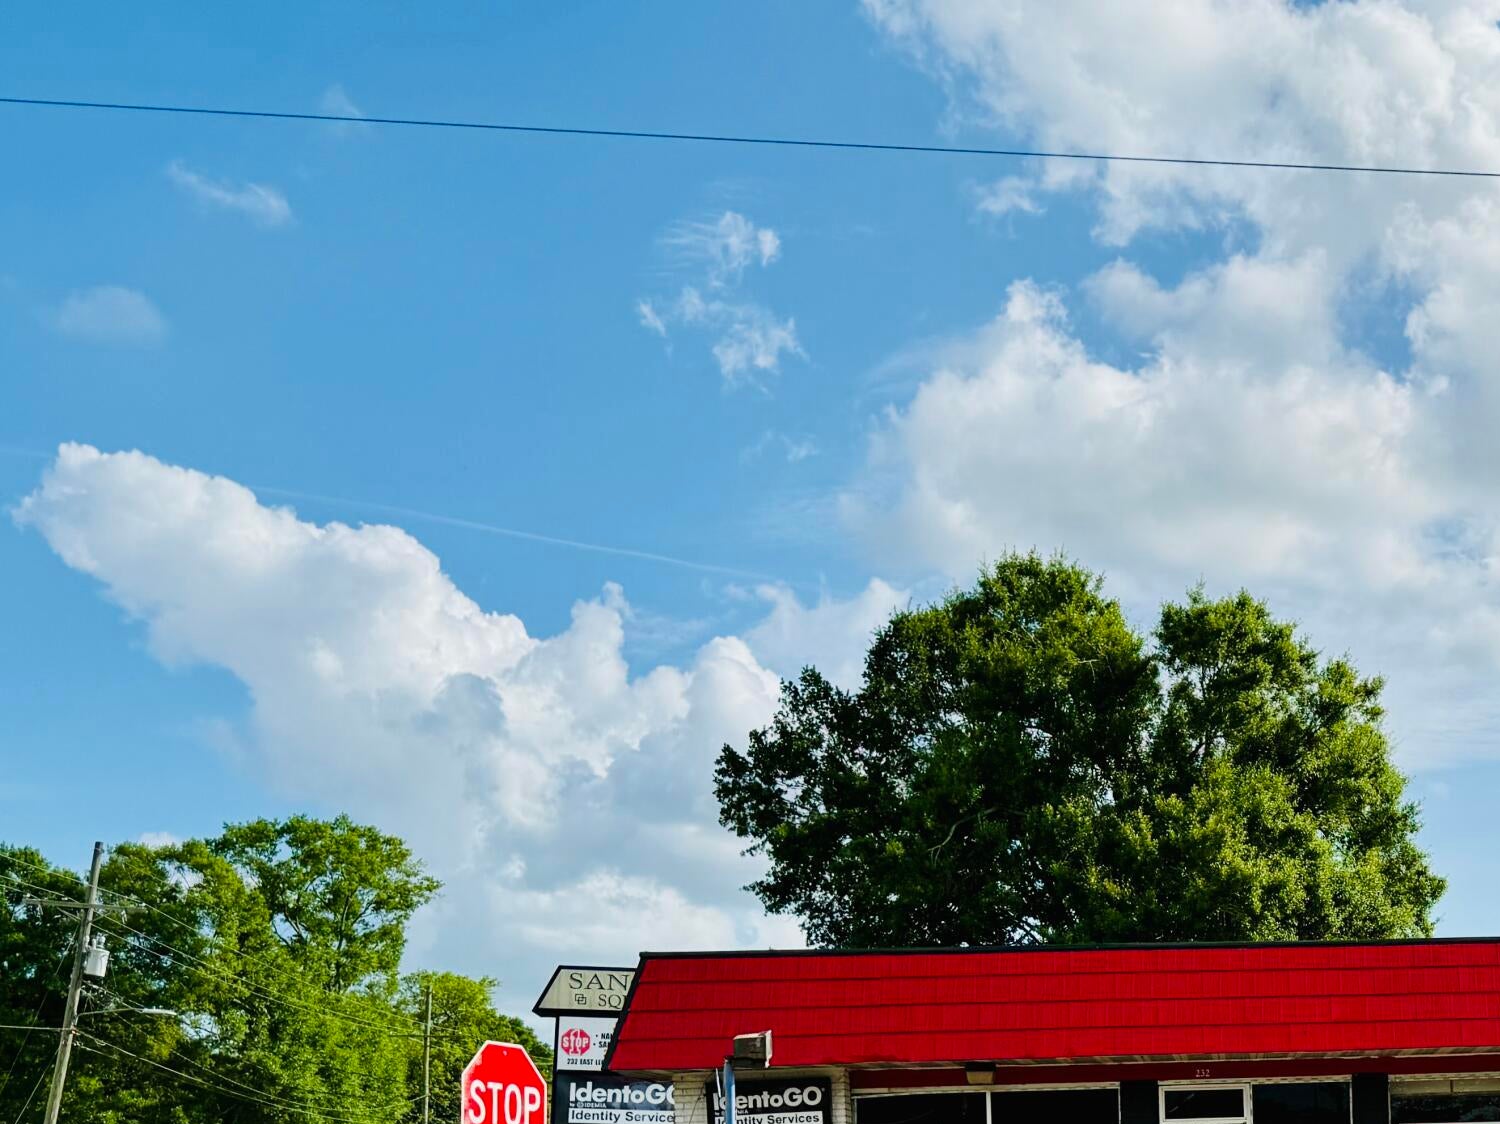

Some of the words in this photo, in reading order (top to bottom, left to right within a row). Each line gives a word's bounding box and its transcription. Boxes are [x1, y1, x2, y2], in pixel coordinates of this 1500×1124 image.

[598, 993, 627, 1009] SQ
[571, 1110, 620, 1123] Identity
[767, 1114, 820, 1124] Services
